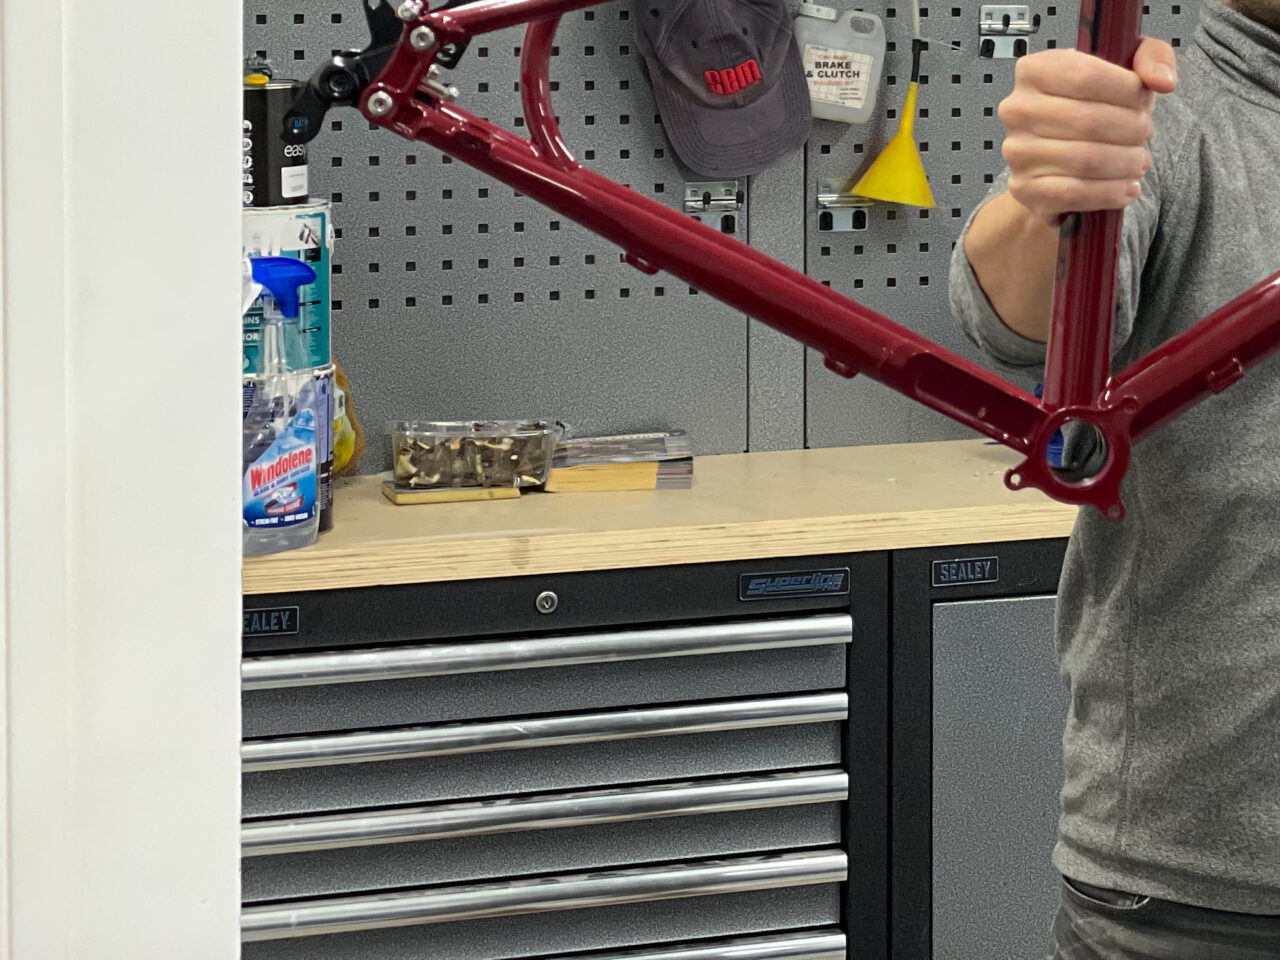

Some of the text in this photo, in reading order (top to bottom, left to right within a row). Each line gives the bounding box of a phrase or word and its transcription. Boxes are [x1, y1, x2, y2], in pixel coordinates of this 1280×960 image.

[806, 70, 860, 78] & CLUTCH
[814, 61, 852, 69] BRAKE
[250, 447, 313, 491] Windolene
[939, 561, 991, 581] SEALEY
[243, 611, 290, 632] EALEY
